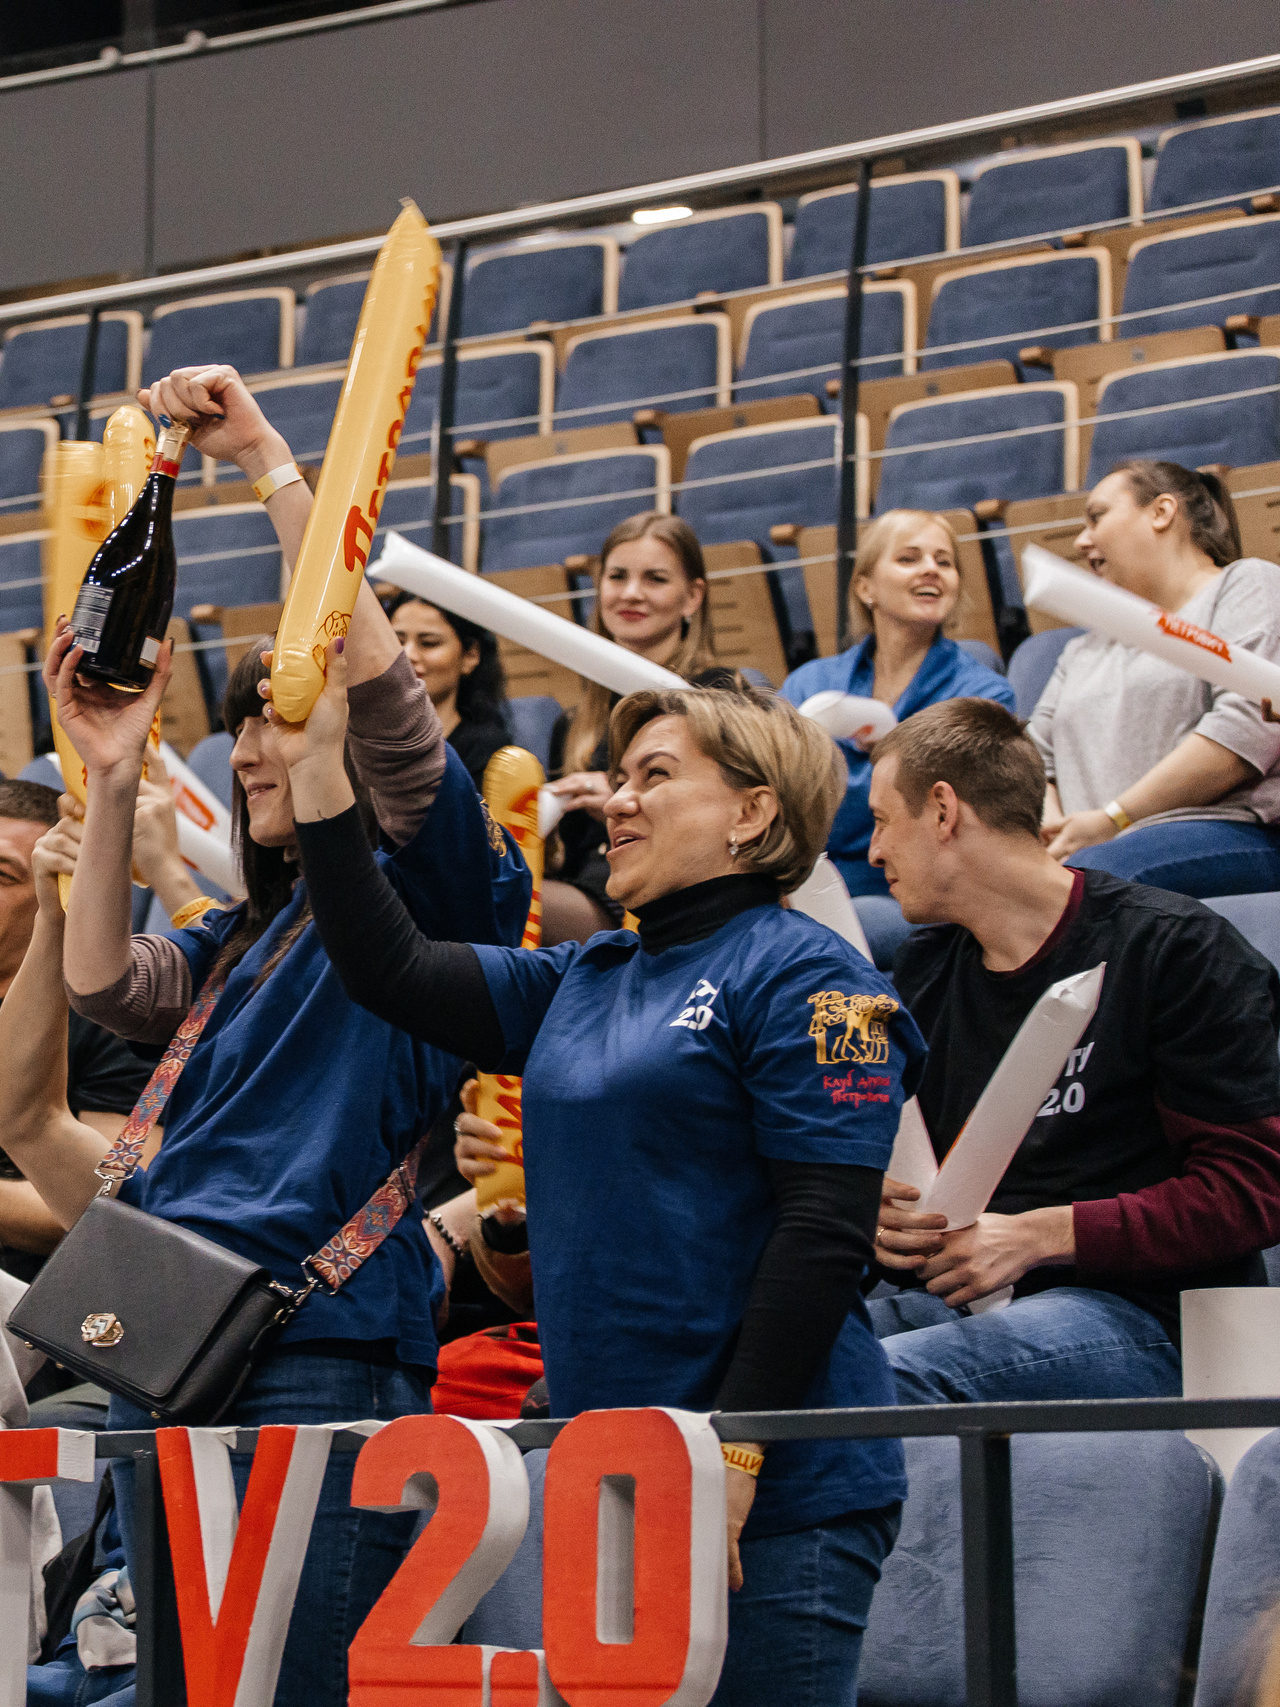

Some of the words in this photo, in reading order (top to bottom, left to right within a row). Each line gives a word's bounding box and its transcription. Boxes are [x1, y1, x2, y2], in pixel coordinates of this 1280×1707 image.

[1065, 1041, 1095, 1077] ТУ
[1036, 1082, 1086, 1117] 2.0
[347, 1407, 705, 1707] 2.0
